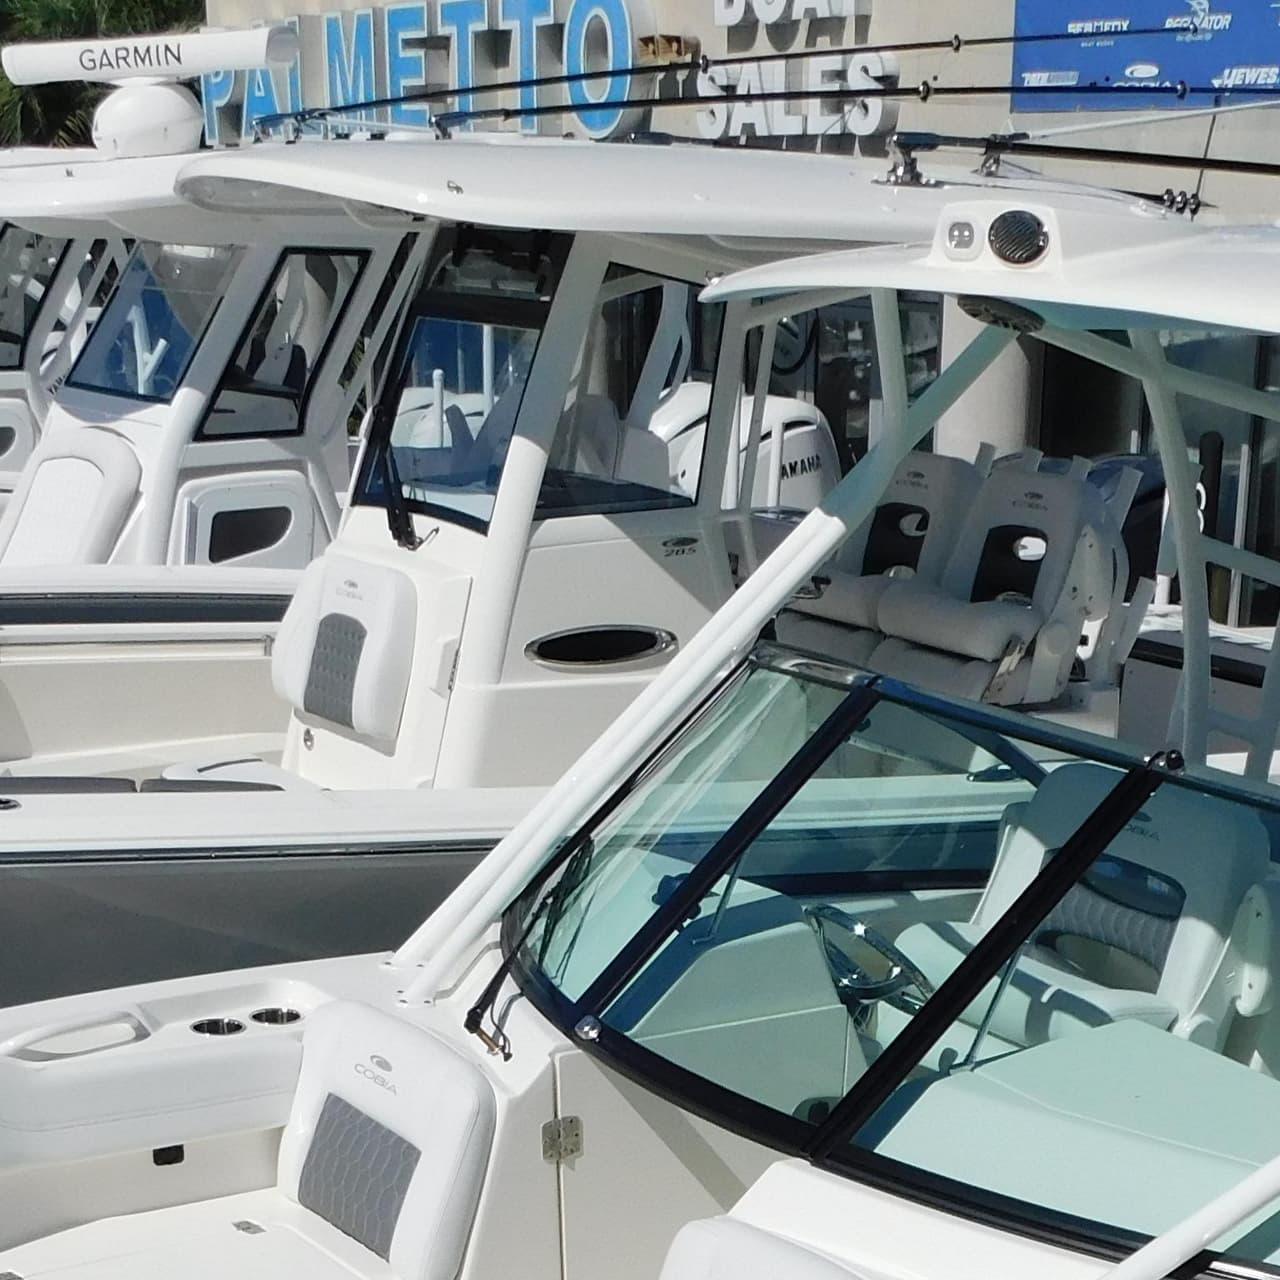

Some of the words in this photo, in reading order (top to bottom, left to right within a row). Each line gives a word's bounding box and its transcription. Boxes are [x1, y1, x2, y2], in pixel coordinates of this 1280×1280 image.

[79, 43, 183, 71] GARMIN
[696, 52, 884, 139] SALES
[781, 452, 822, 480] AMAHA
[354, 1063, 398, 1097] COBIA
